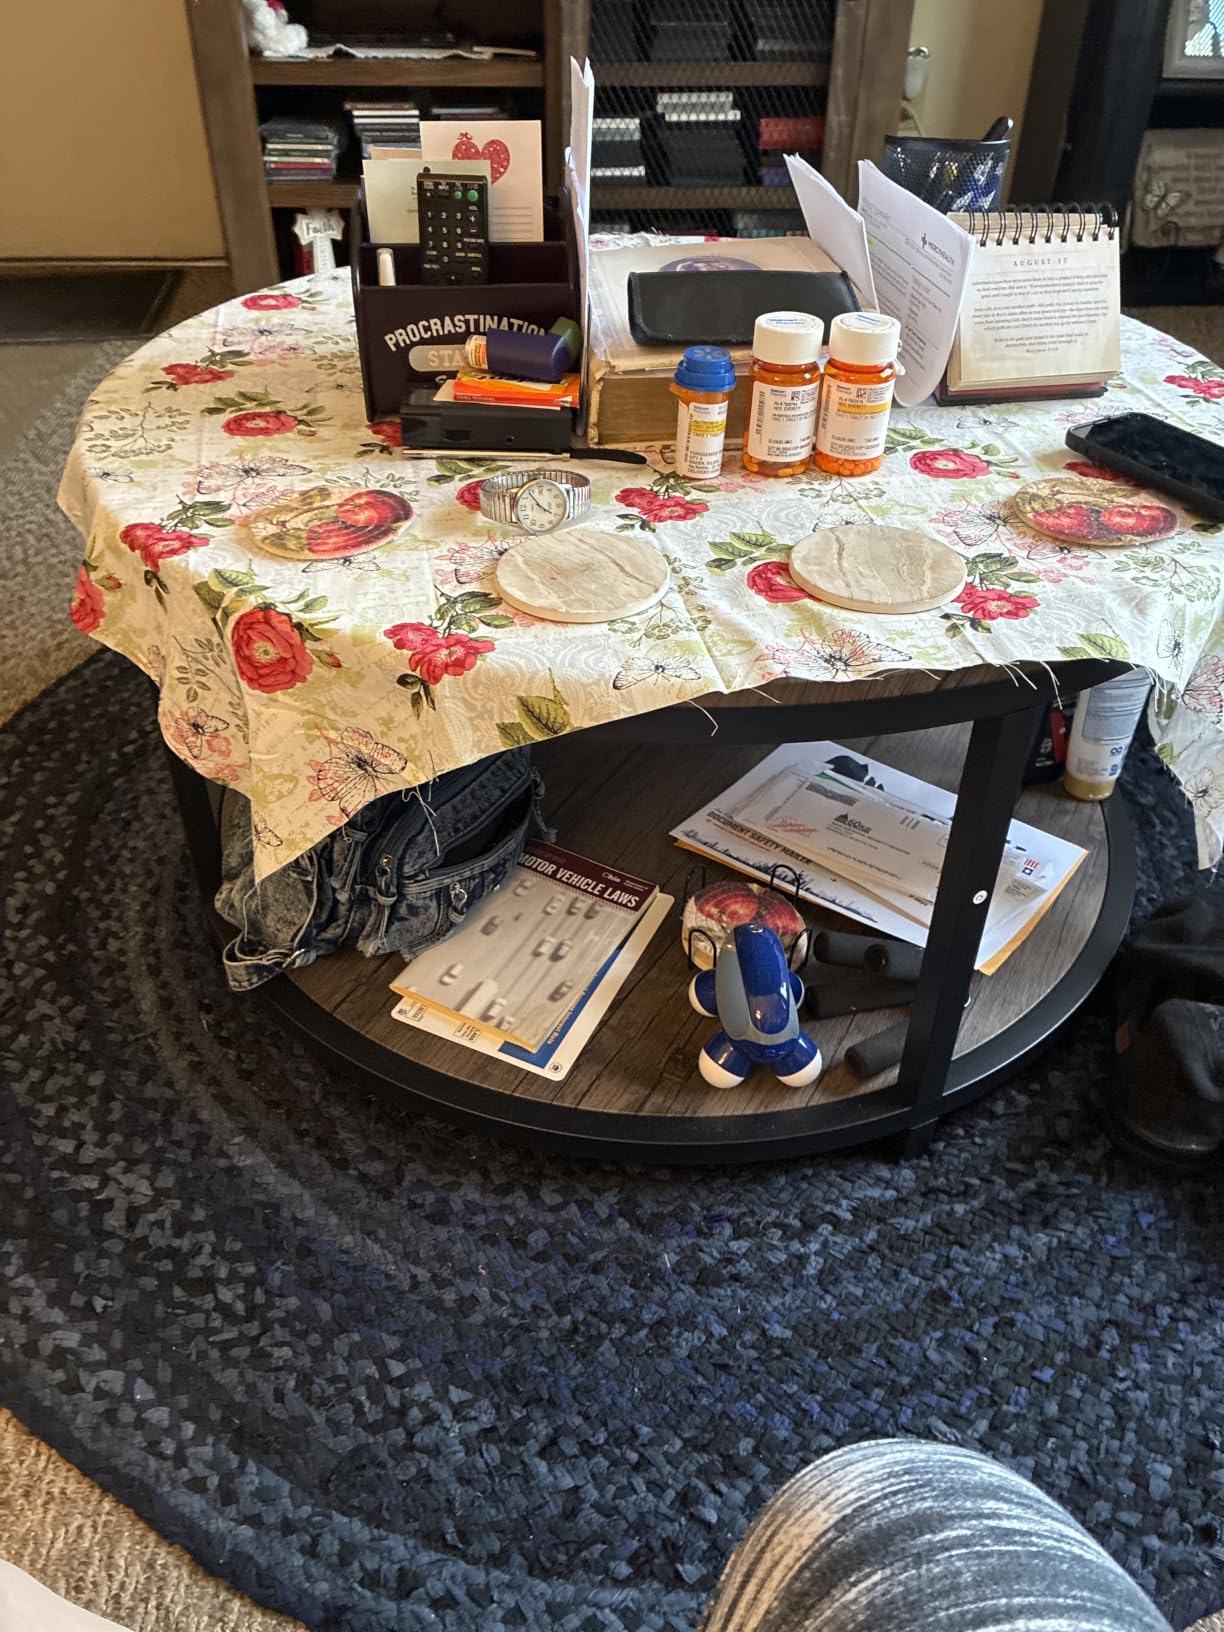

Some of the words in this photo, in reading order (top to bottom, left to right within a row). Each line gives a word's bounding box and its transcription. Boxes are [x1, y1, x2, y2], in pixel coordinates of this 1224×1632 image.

[1012, 258, 1051, 267] AUGUST
[1057, 257, 1068, 265] 17
[707, 810, 750, 836] DOCUMENT
[749, 829, 781, 850] SAFETY
[779, 846, 814, 866] MAILER
[519, 852, 557, 876] MOTOR
[555, 867, 606, 895] VEHICLE
[603, 887, 640, 908] LAWS
[602, 871, 622, 883] Ohio
